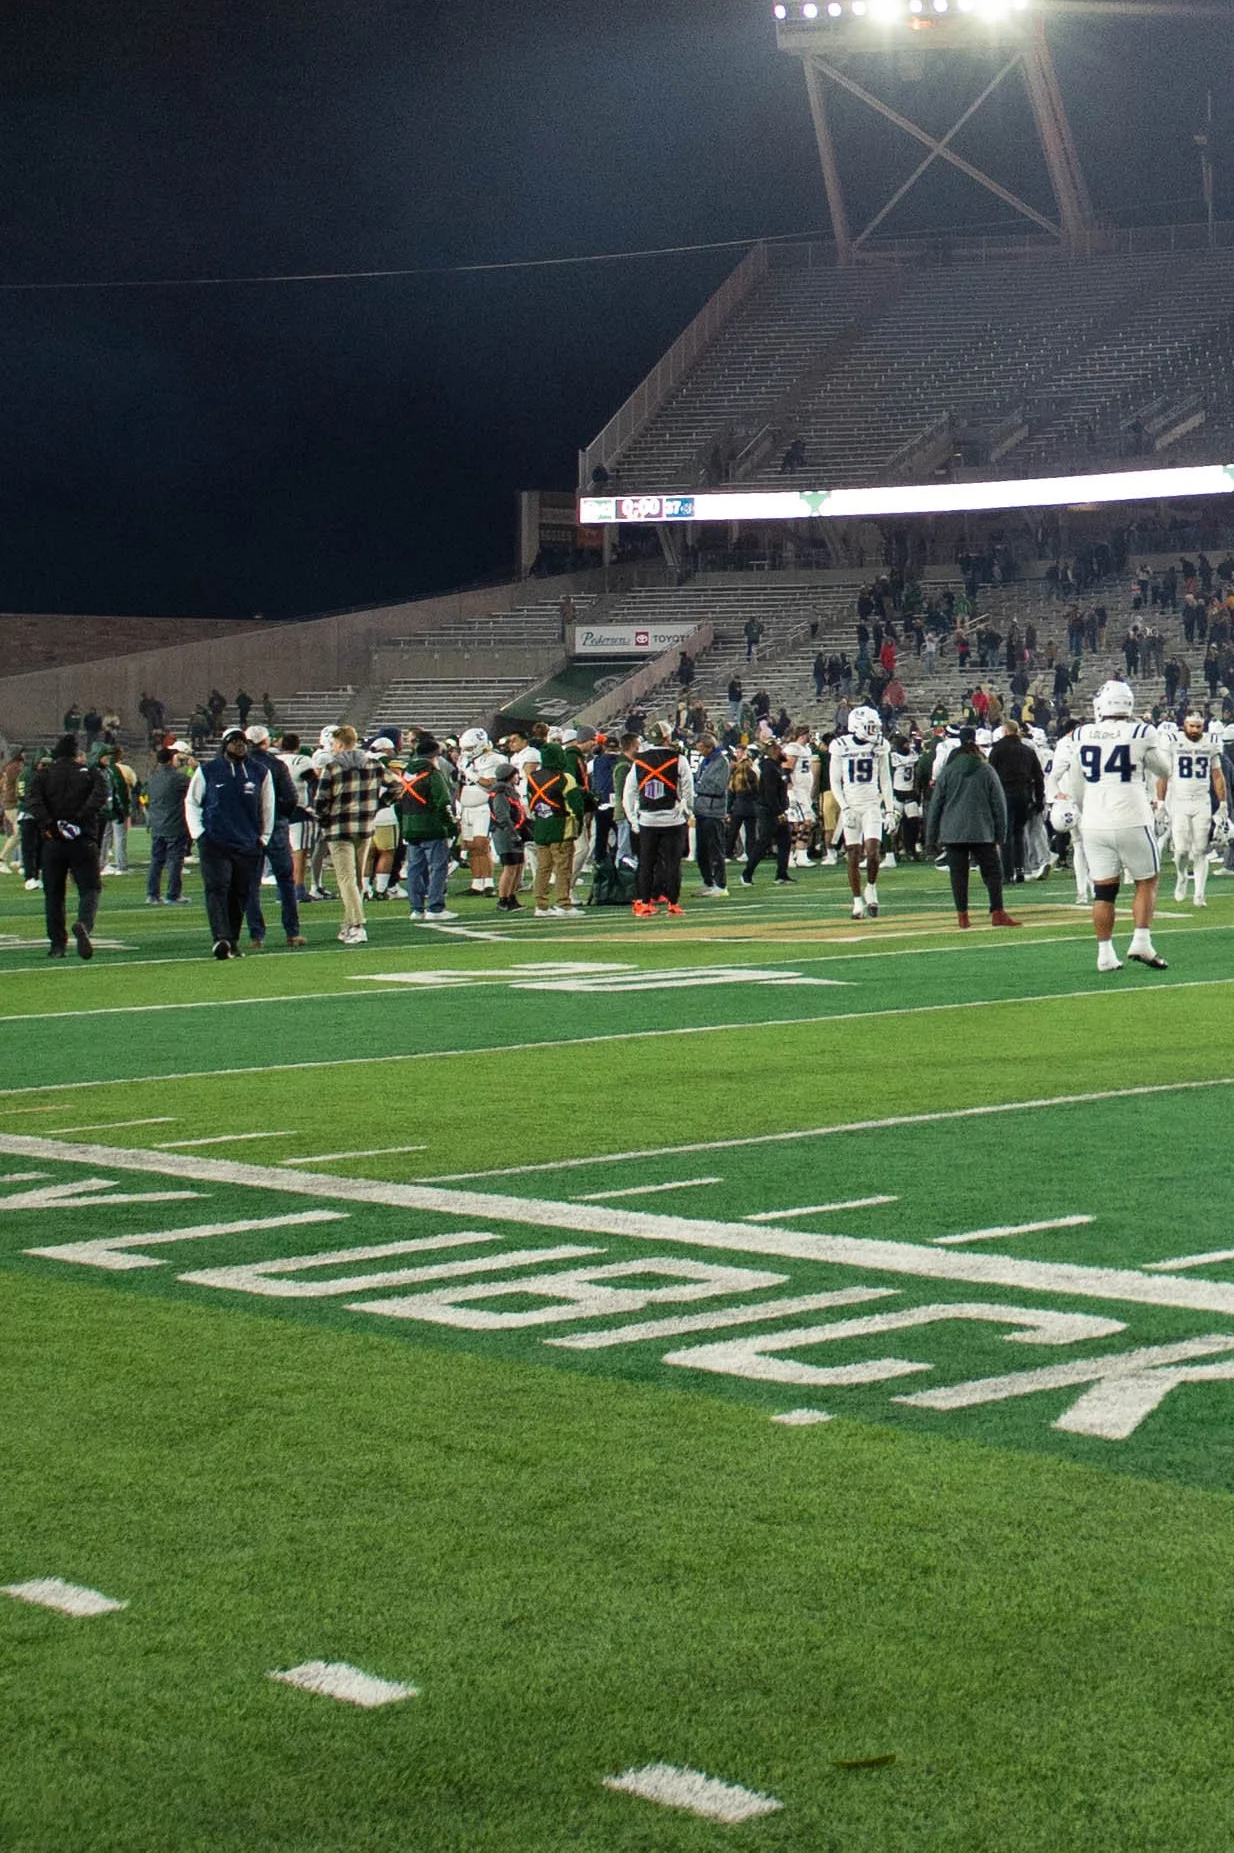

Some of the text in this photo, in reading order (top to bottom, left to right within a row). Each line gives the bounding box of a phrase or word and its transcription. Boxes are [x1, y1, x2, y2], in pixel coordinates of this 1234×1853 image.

[653, 634, 690, 644] TOYOT
[848, 759, 874, 783] 19
[1080, 744, 1137, 783] 94
[1178, 756, 1209, 779] 83
